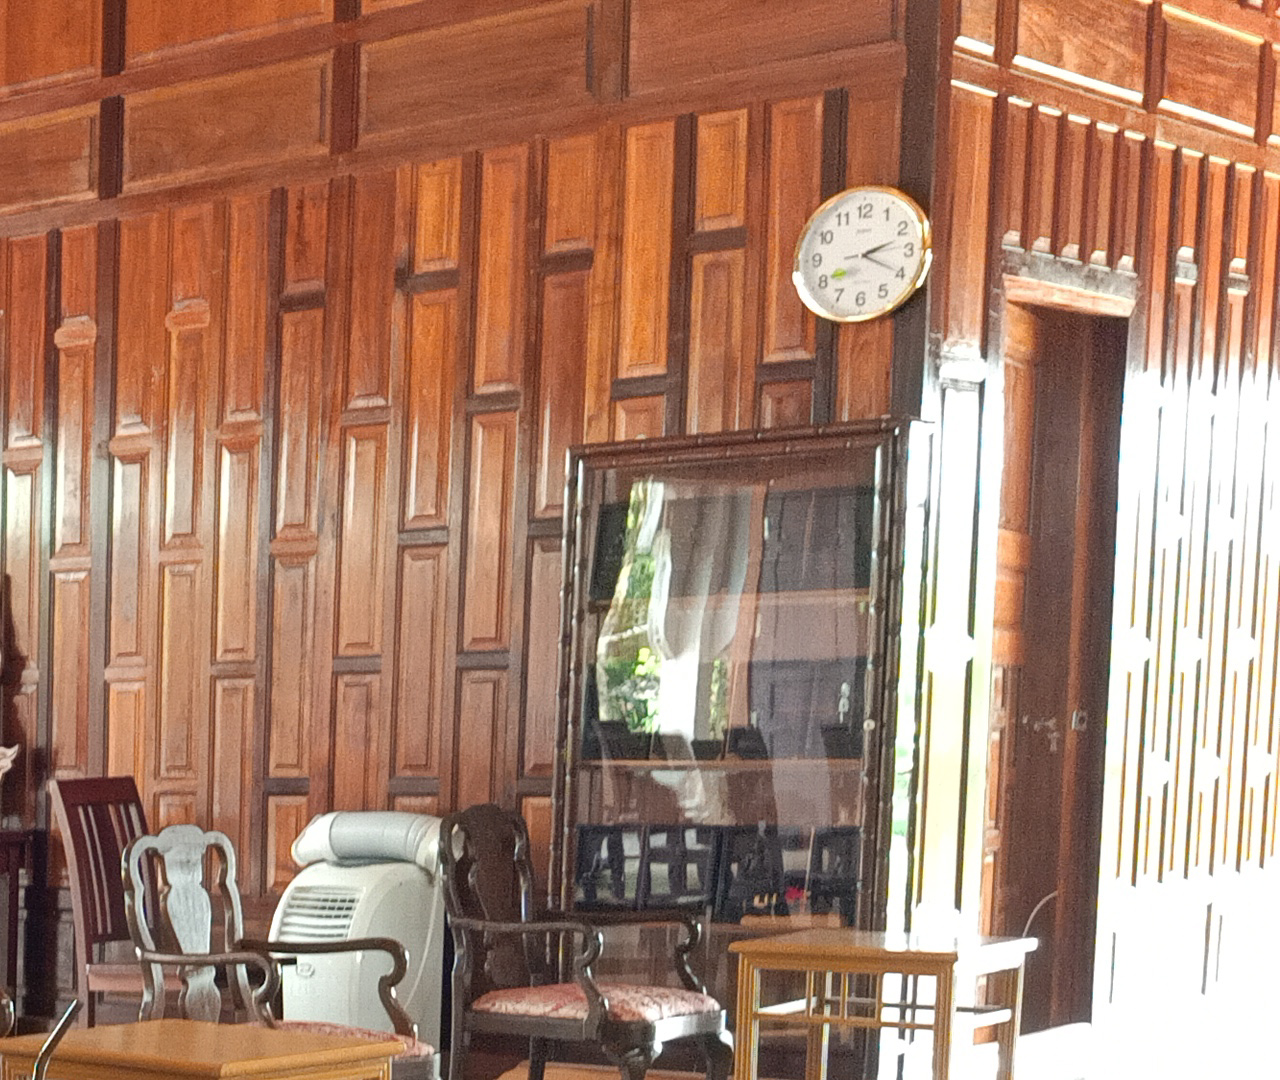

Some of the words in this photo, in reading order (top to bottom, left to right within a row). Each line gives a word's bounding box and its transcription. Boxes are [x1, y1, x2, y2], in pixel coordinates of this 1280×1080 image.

[857, 204, 873, 218] 12
[884, 208, 890, 221] 1
[836, 212, 850, 226] 11
[897, 221, 908, 236] 2
[820, 230, 833, 245] 10
[904, 243, 914, 257] 3
[812, 253, 822, 268] 9
[895, 267, 906, 280] 4
[819, 275, 828, 289] 8
[835, 288, 844, 303] 7
[878, 285, 888, 298] 5
[856, 292, 865, 306] 6
